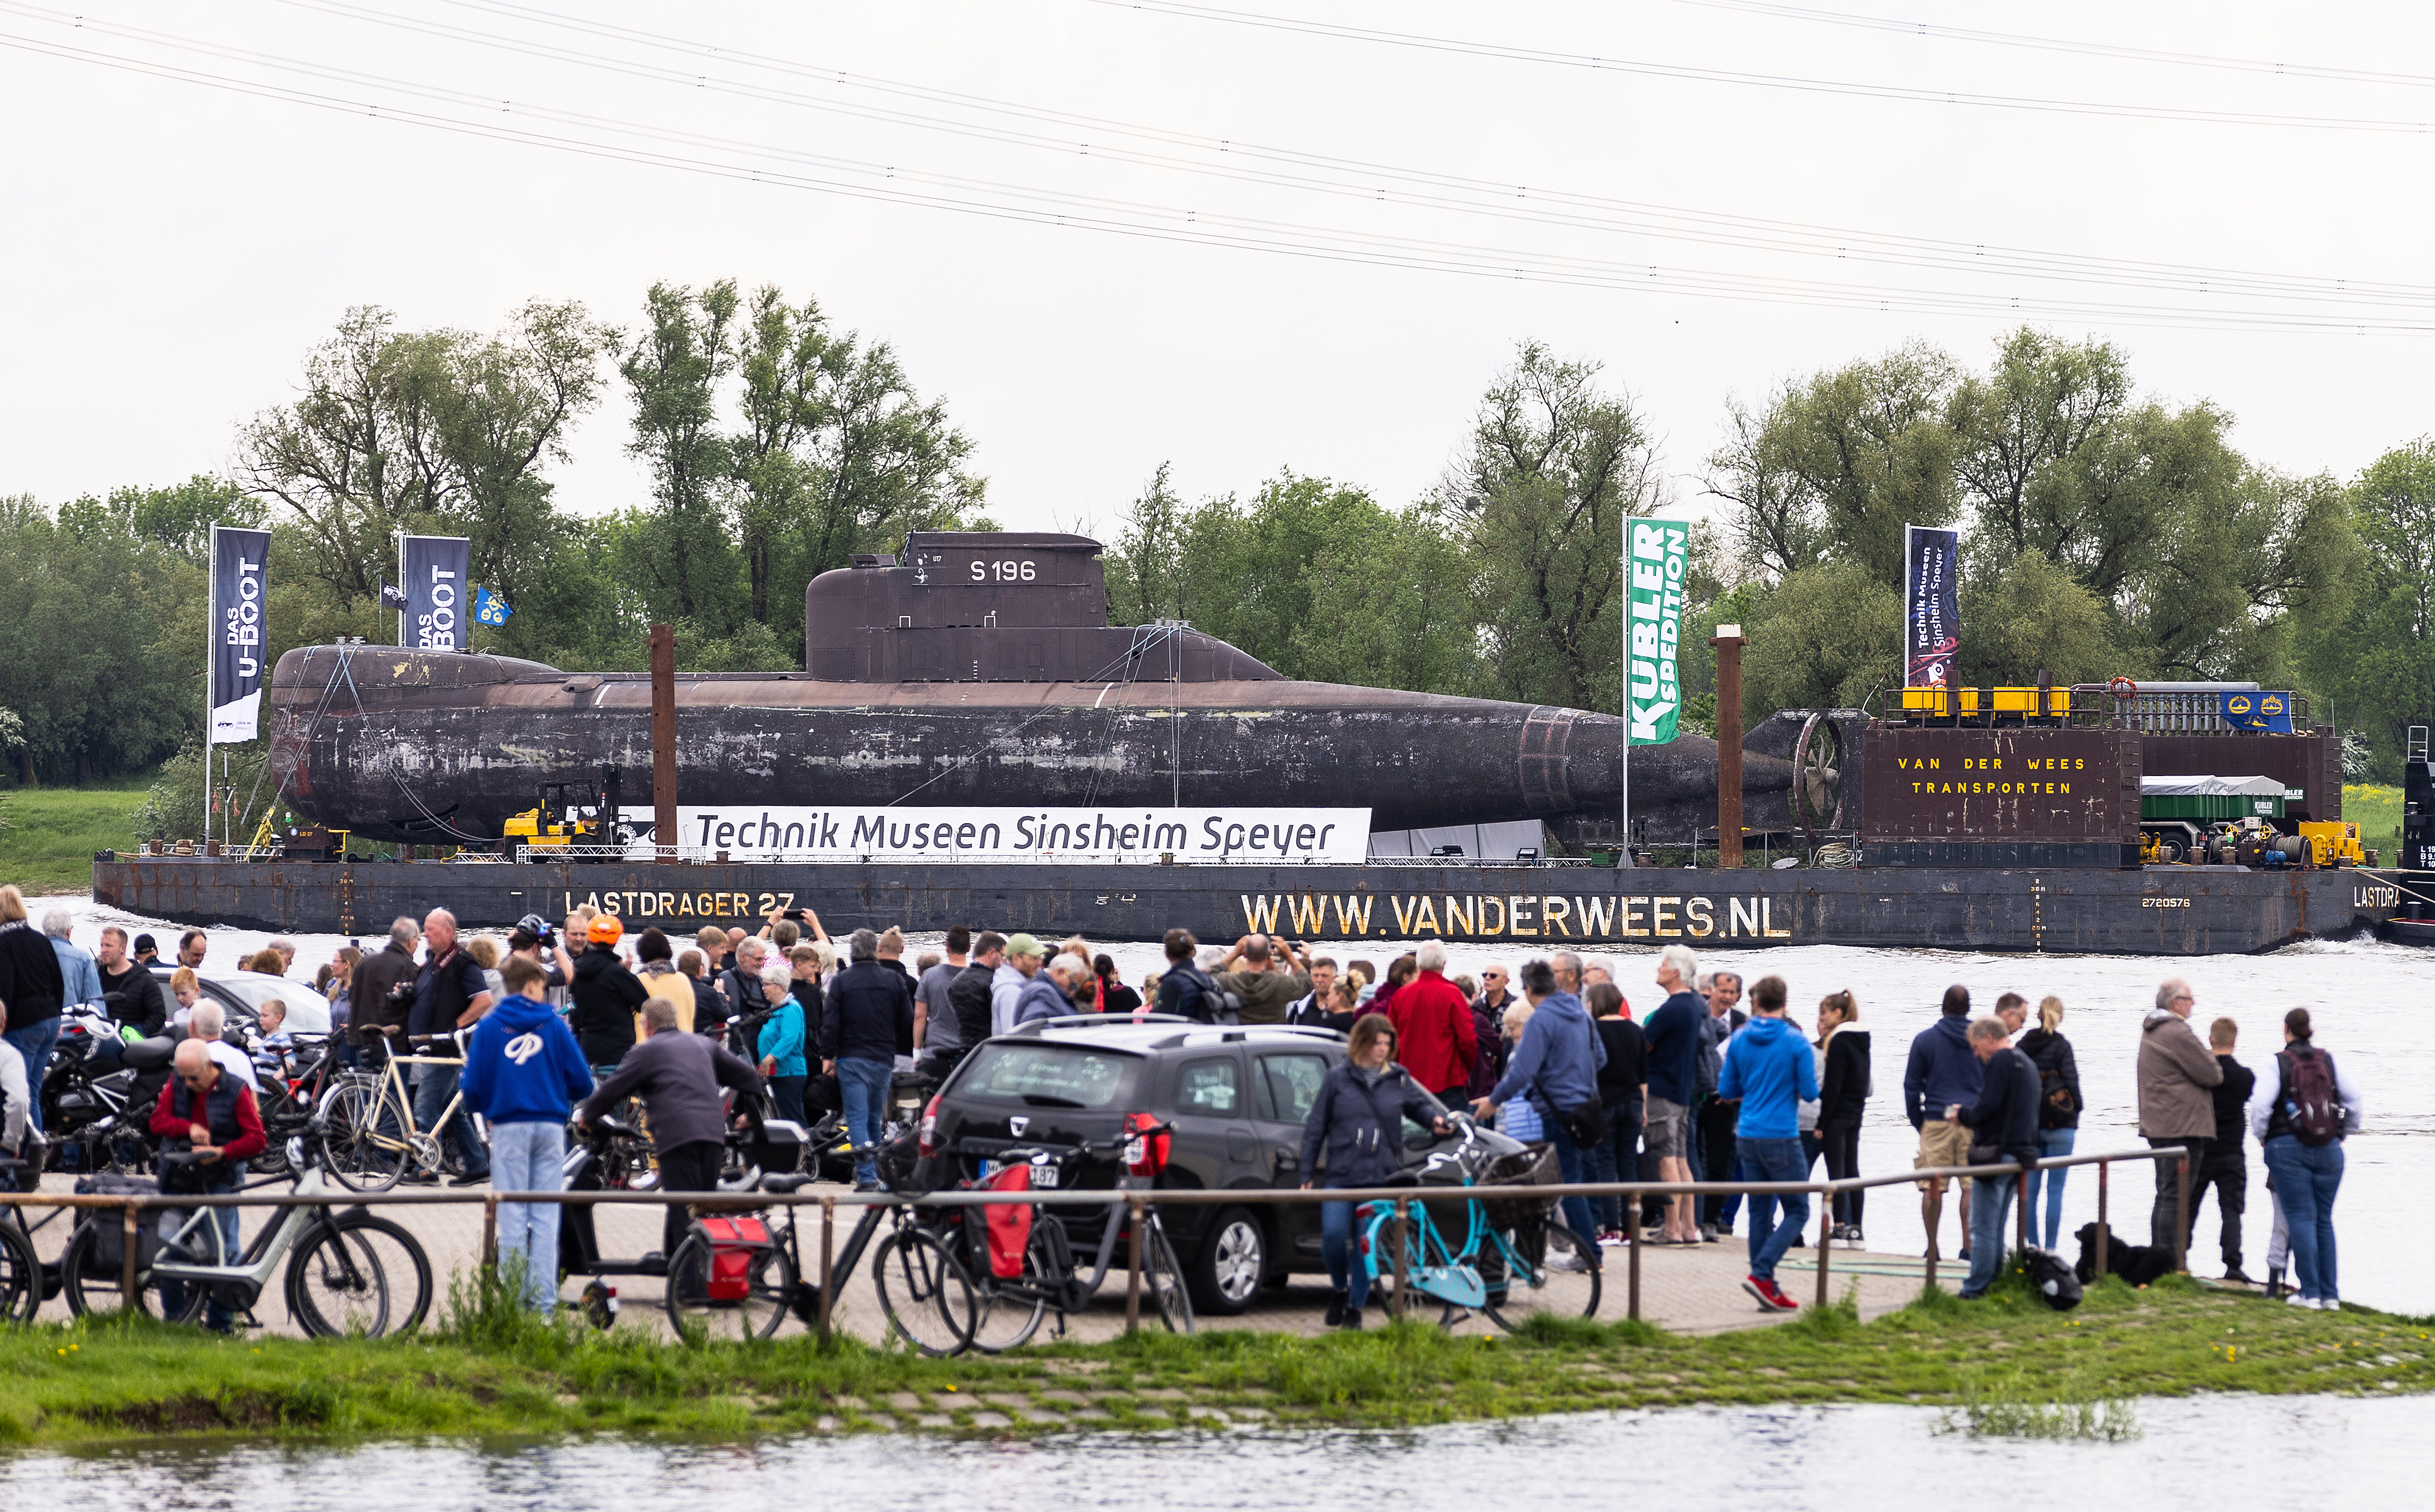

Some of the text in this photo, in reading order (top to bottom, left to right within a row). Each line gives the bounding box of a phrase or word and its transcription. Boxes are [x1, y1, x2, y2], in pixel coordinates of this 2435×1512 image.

[970, 561, 1036, 581] S 196
[1660, 527, 1685, 703] SPEDITION
[1916, 546, 1931, 648] Technik Museen
[1929, 547, 1946, 647] Sinsheim Speyer
[227, 606, 240, 645] DAS
[239, 557, 259, 677] U-BOOT
[418, 613, 432, 649] DAS
[1898, 758, 2084, 770] VAN DER WEES
[1912, 782, 2070, 794] TRANSPORTEN
[697, 812, 1335, 856] Technik Museen Sinsheim Speyer
[565, 892, 794, 916] LASTDRAGER 27
[1240, 894, 1791, 938] WWW.VANDERWEES.NL
[2142, 898, 2190, 907] 2720576
[1032, 1167, 1056, 1184] 187
